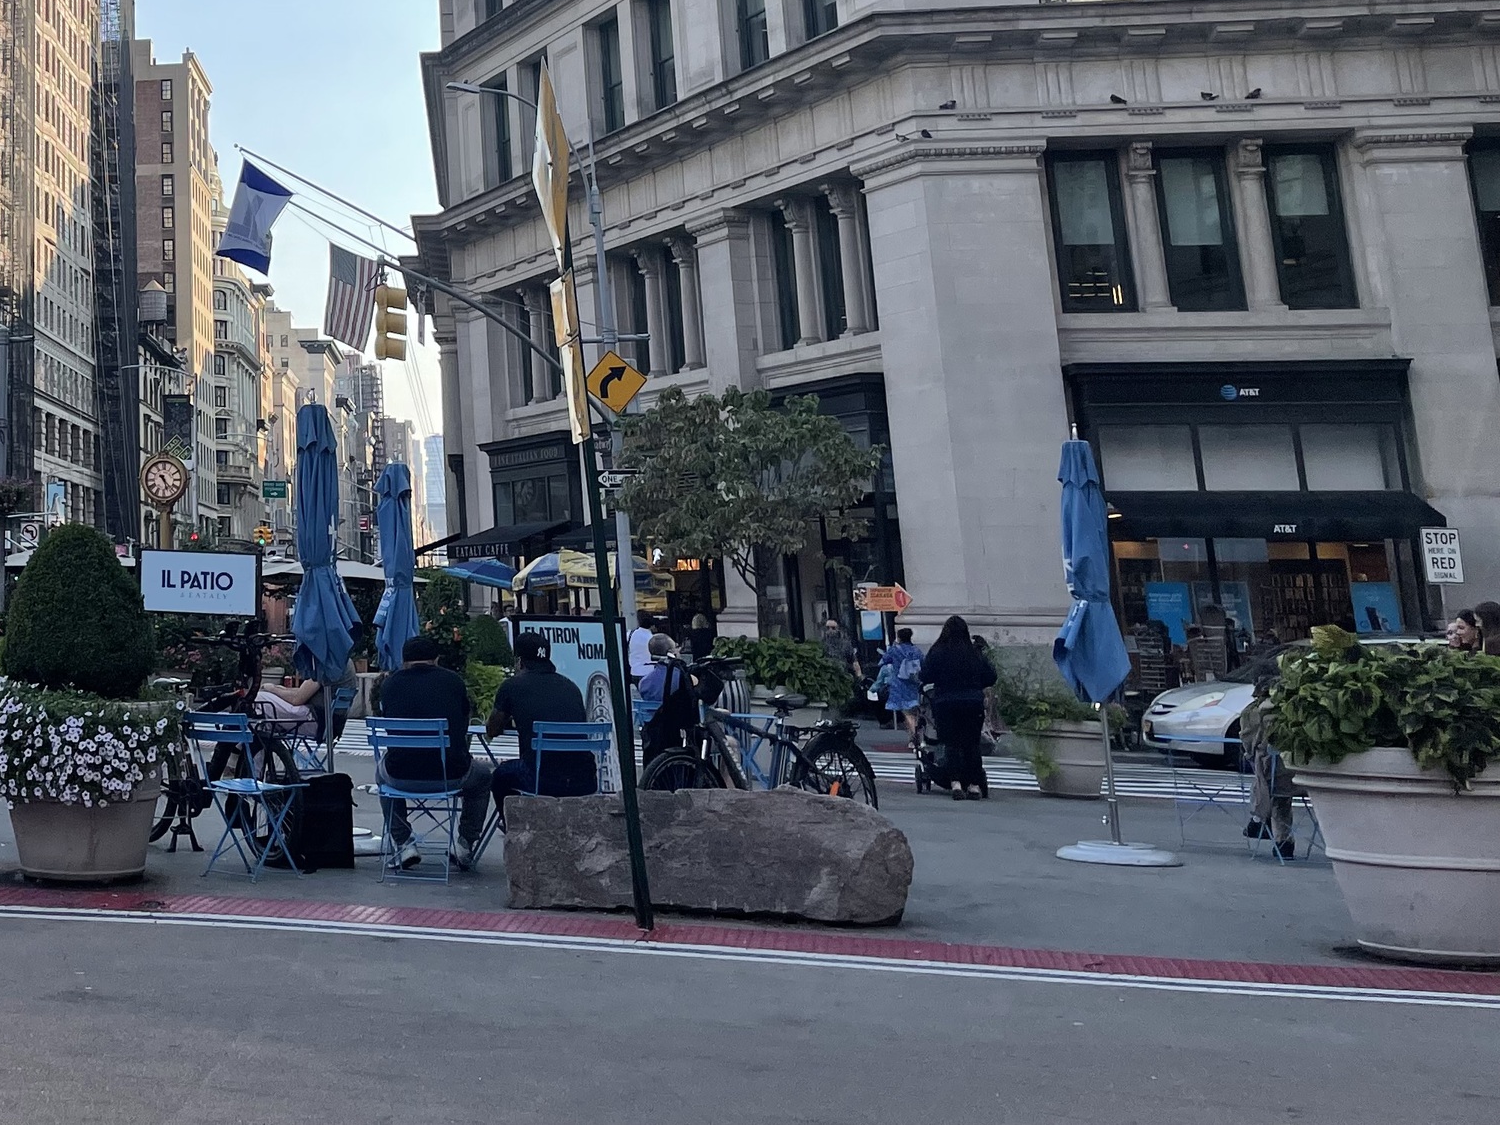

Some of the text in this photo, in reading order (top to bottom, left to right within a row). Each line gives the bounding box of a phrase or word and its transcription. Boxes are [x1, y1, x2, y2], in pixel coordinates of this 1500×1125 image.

[1239, 388, 1260, 396] AT&T
[602, 475, 618, 483] ONE
[1273, 524, 1297, 533] AT&T
[1425, 532, 1456, 545] STOP
[455, 545, 482, 557] EATALY
[1428, 547, 1444, 555] HERE
[1431, 557, 1456, 570] RED
[161, 569, 234, 591] IL PATIO
[188, 592, 228, 600] EATALY
[578, 643, 608, 660] NOM
